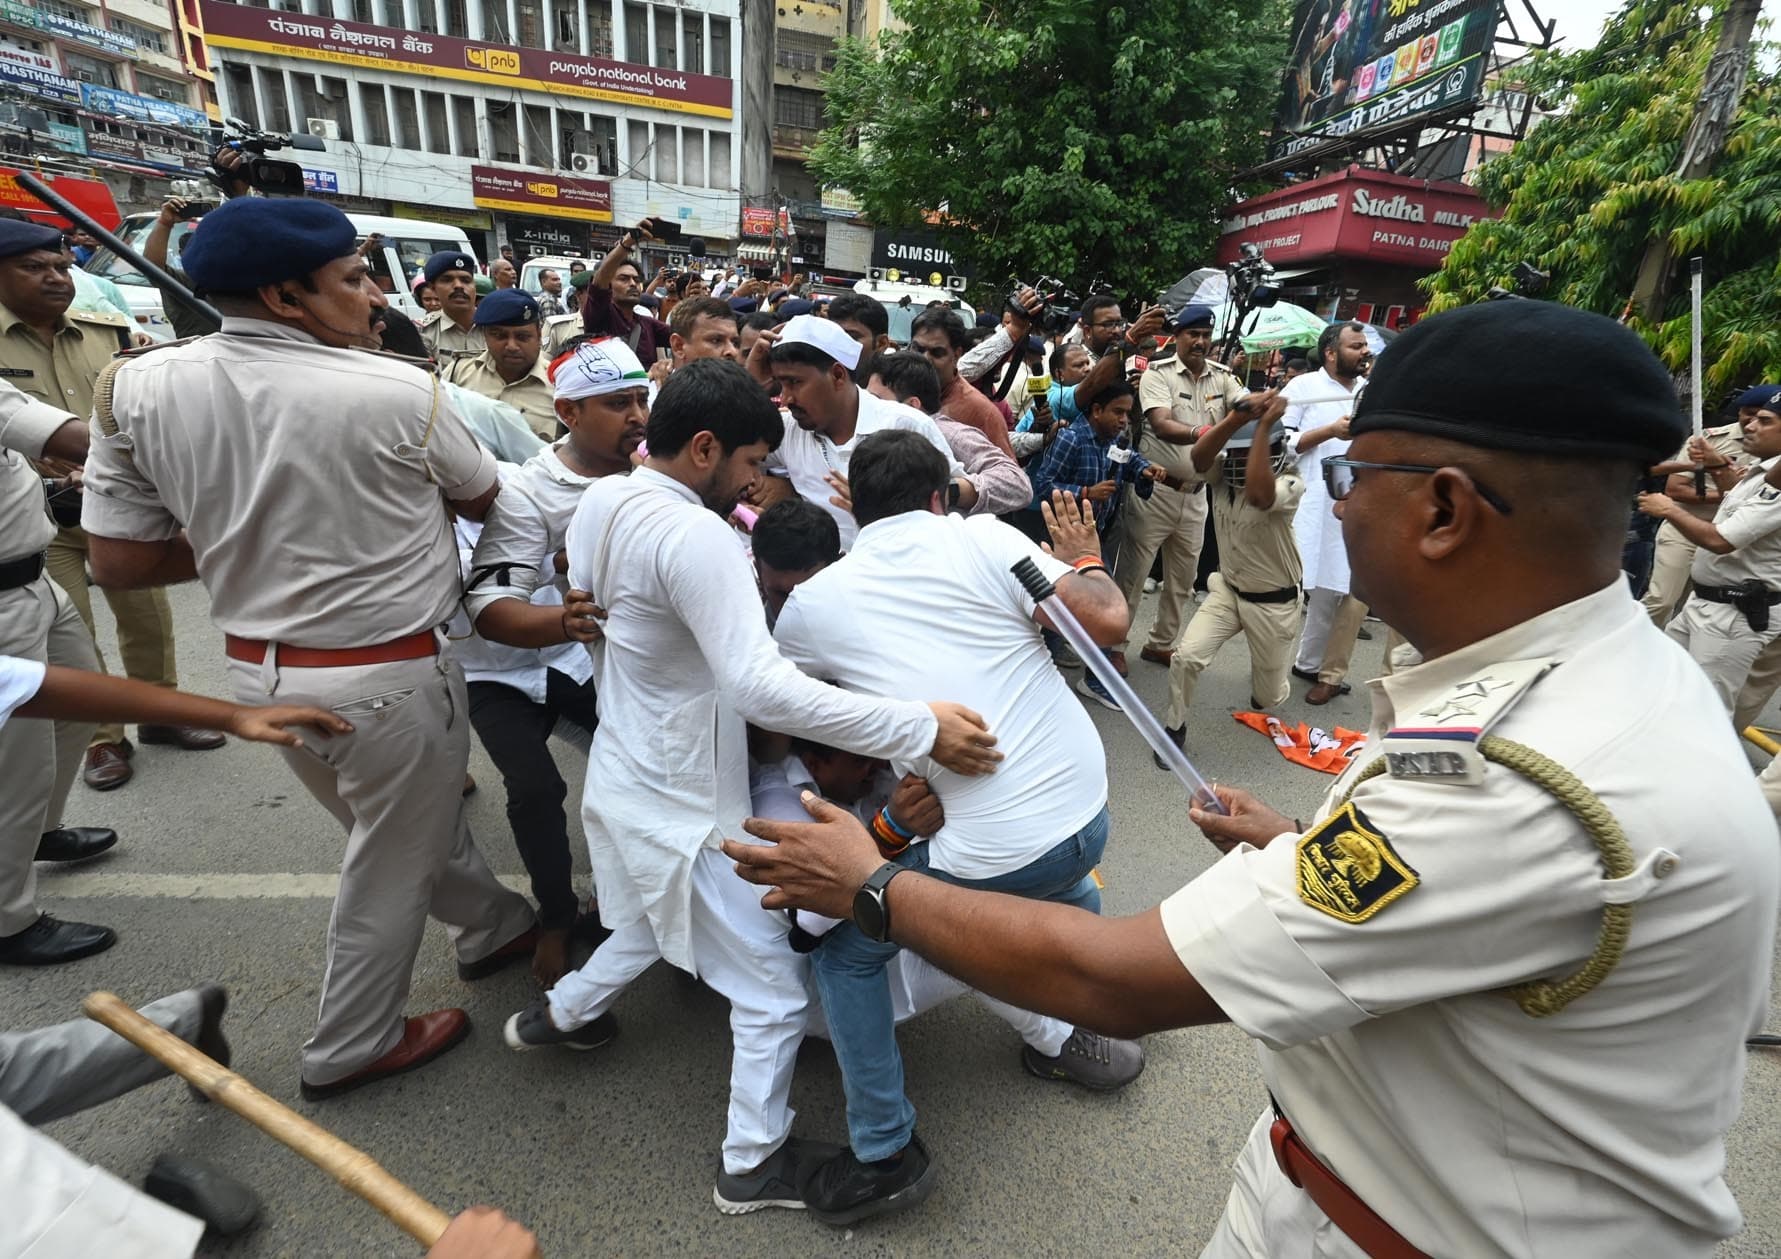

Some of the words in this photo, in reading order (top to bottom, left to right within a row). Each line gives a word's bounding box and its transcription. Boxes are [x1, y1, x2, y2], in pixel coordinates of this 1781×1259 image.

[57, 16, 135, 47] PRASTHANAM
[268, 17, 325, 38] पंजाब
[329, 23, 396, 49] नैशनल
[402, 34, 433, 53] बैंक
[33, 56, 52, 69] IAS
[490, 54, 516, 69] pnb
[550, 61, 596, 78] punjab
[599, 67, 652, 86] national
[655, 72, 687, 91] bank
[540, 186, 555, 194] pnb
[1299, 193, 1339, 214] PARLOUR
[1352, 188, 1426, 223] Sudha
[1432, 211, 1474, 228] MILK
[1273, 234, 1301, 248] PROJECT
[1373, 231, 1415, 247] PATNA
[1418, 237, 1451, 252] DAIR
[1328, 873, 1361, 910] पुलिस
